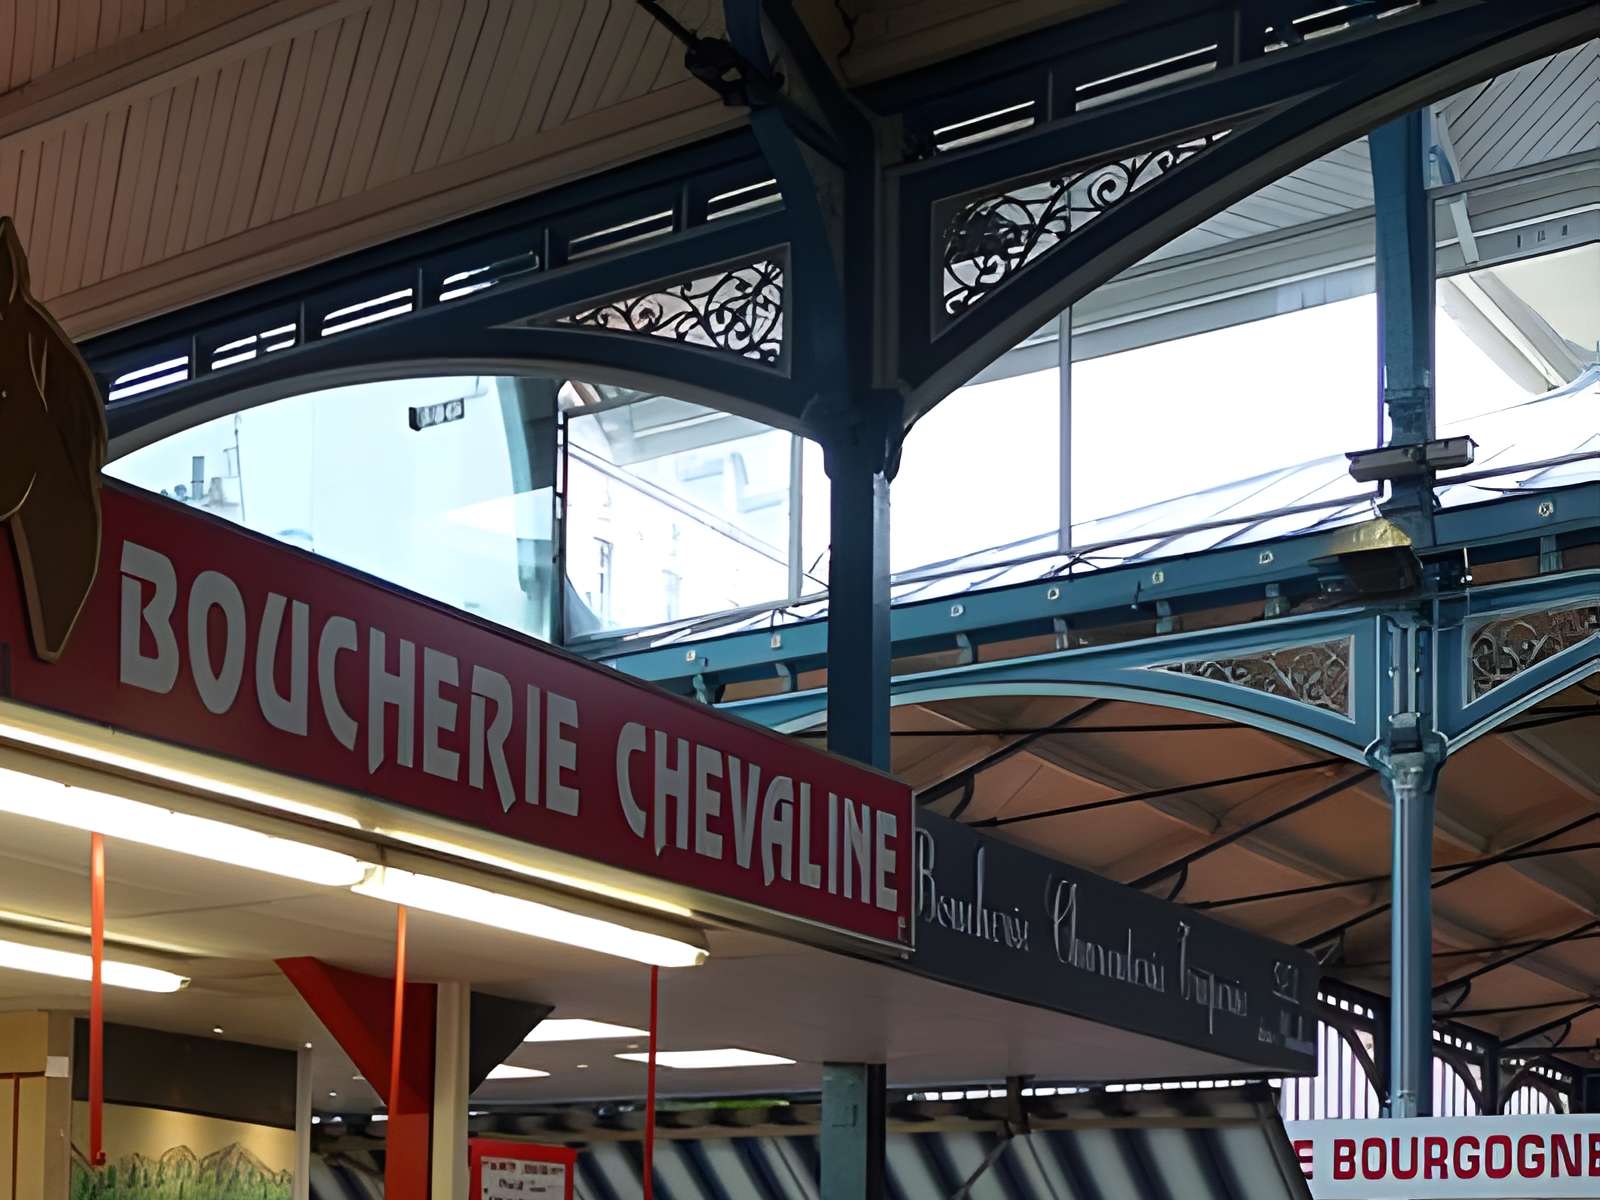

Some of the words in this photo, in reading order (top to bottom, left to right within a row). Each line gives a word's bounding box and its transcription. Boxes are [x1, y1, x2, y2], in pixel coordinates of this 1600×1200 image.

[120, 540, 580, 816] BOUCHERIE
[615, 721, 898, 913] CHEVALINE
[1332, 1132, 1600, 1181] BOURGOGNE
